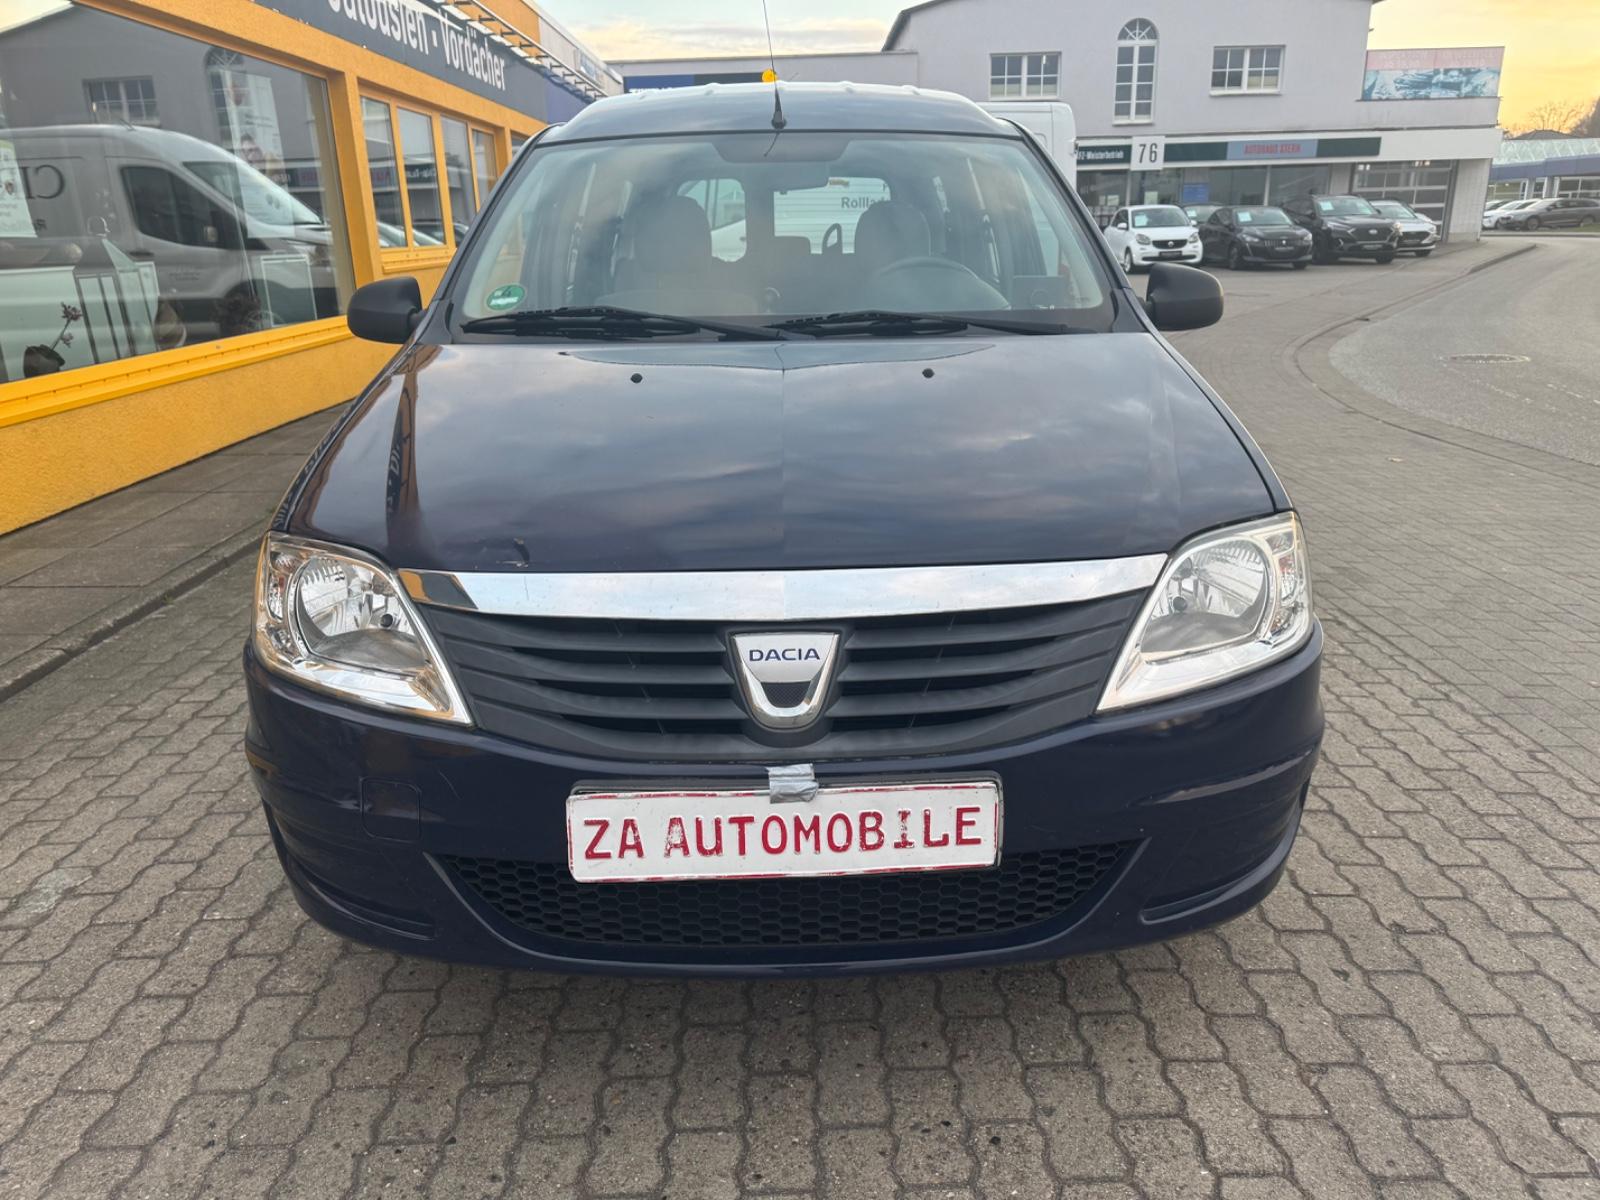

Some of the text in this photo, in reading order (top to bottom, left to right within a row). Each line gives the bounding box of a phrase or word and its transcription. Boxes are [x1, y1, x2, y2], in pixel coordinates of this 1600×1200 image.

[327, 0, 506, 91] ousien Vordächer
[1139, 143, 1158, 164] 76
[749, 648, 820, 661] DACIA
[583, 807, 982, 860] ZA AUTOMOBILE
